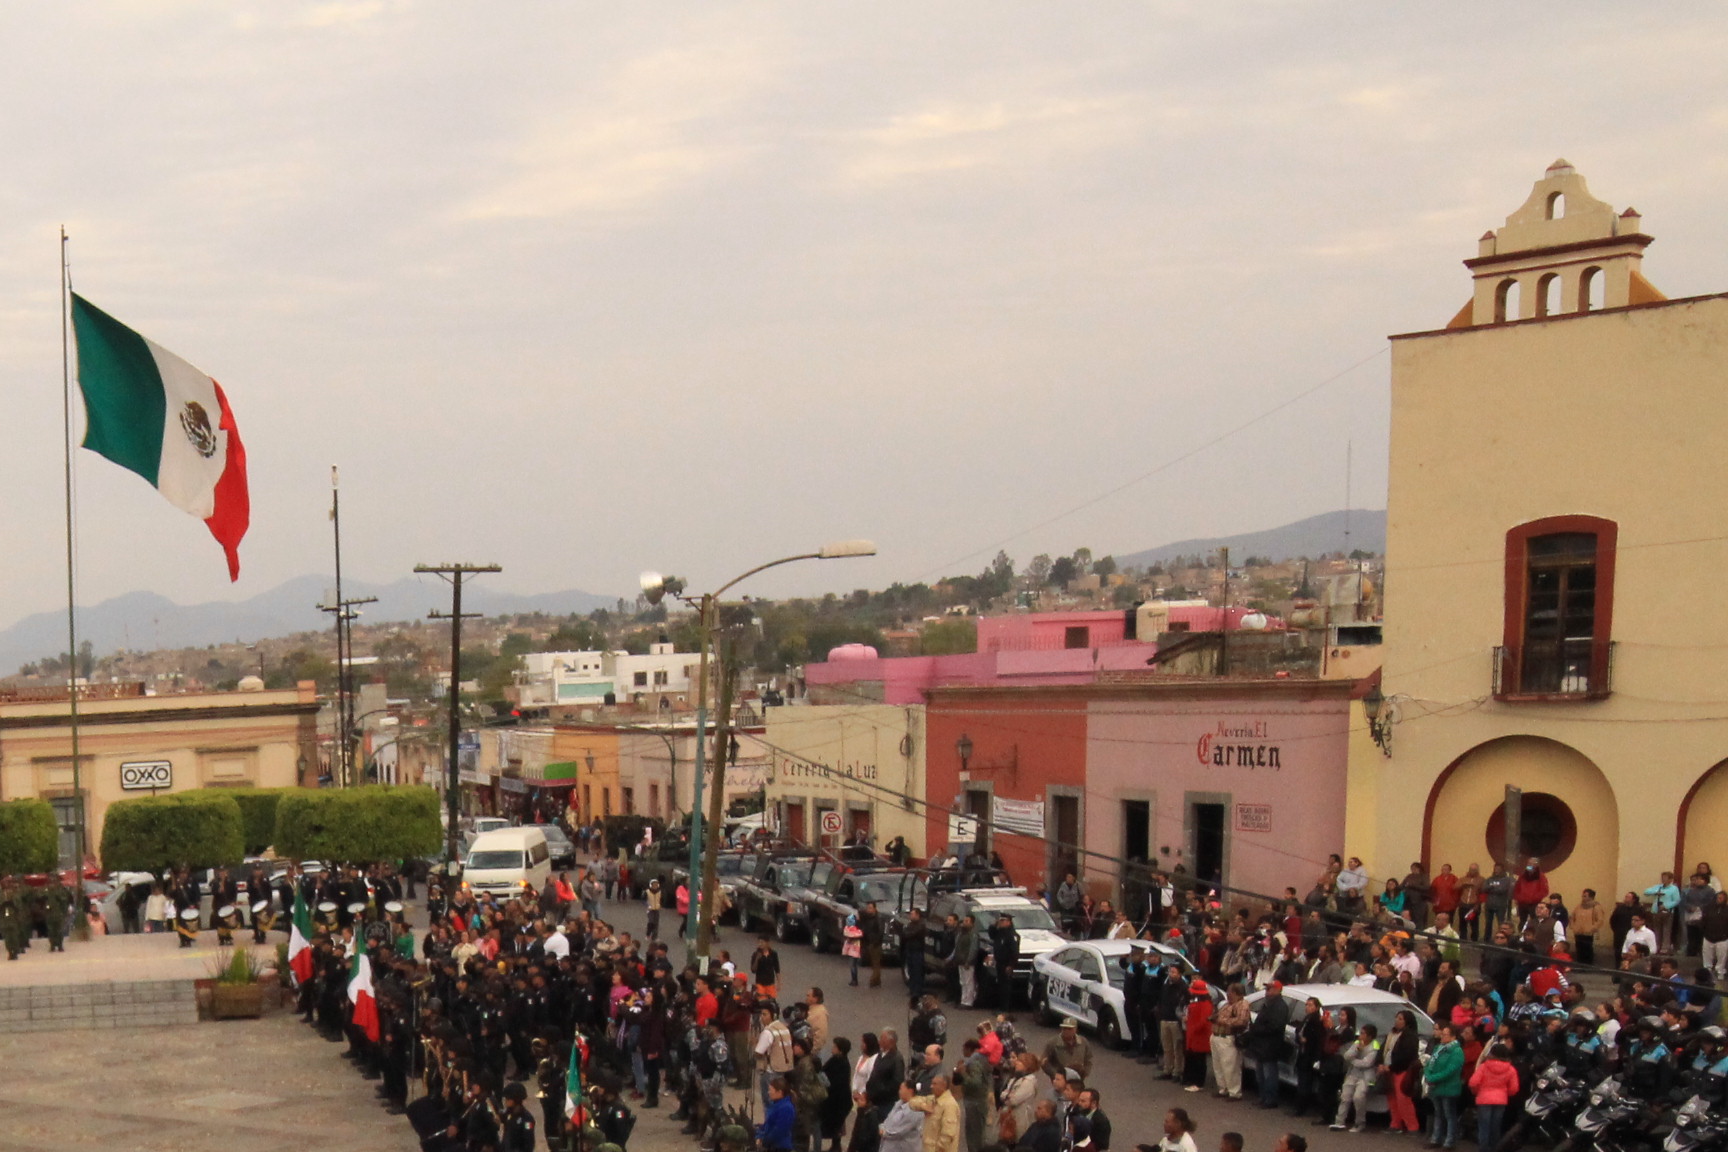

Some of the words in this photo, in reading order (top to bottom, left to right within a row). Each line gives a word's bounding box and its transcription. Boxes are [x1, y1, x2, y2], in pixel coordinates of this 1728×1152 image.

[1197, 733, 1281, 771] Carmen
[124, 765, 169, 784] OXXO
[957, 821, 968, 836] E
